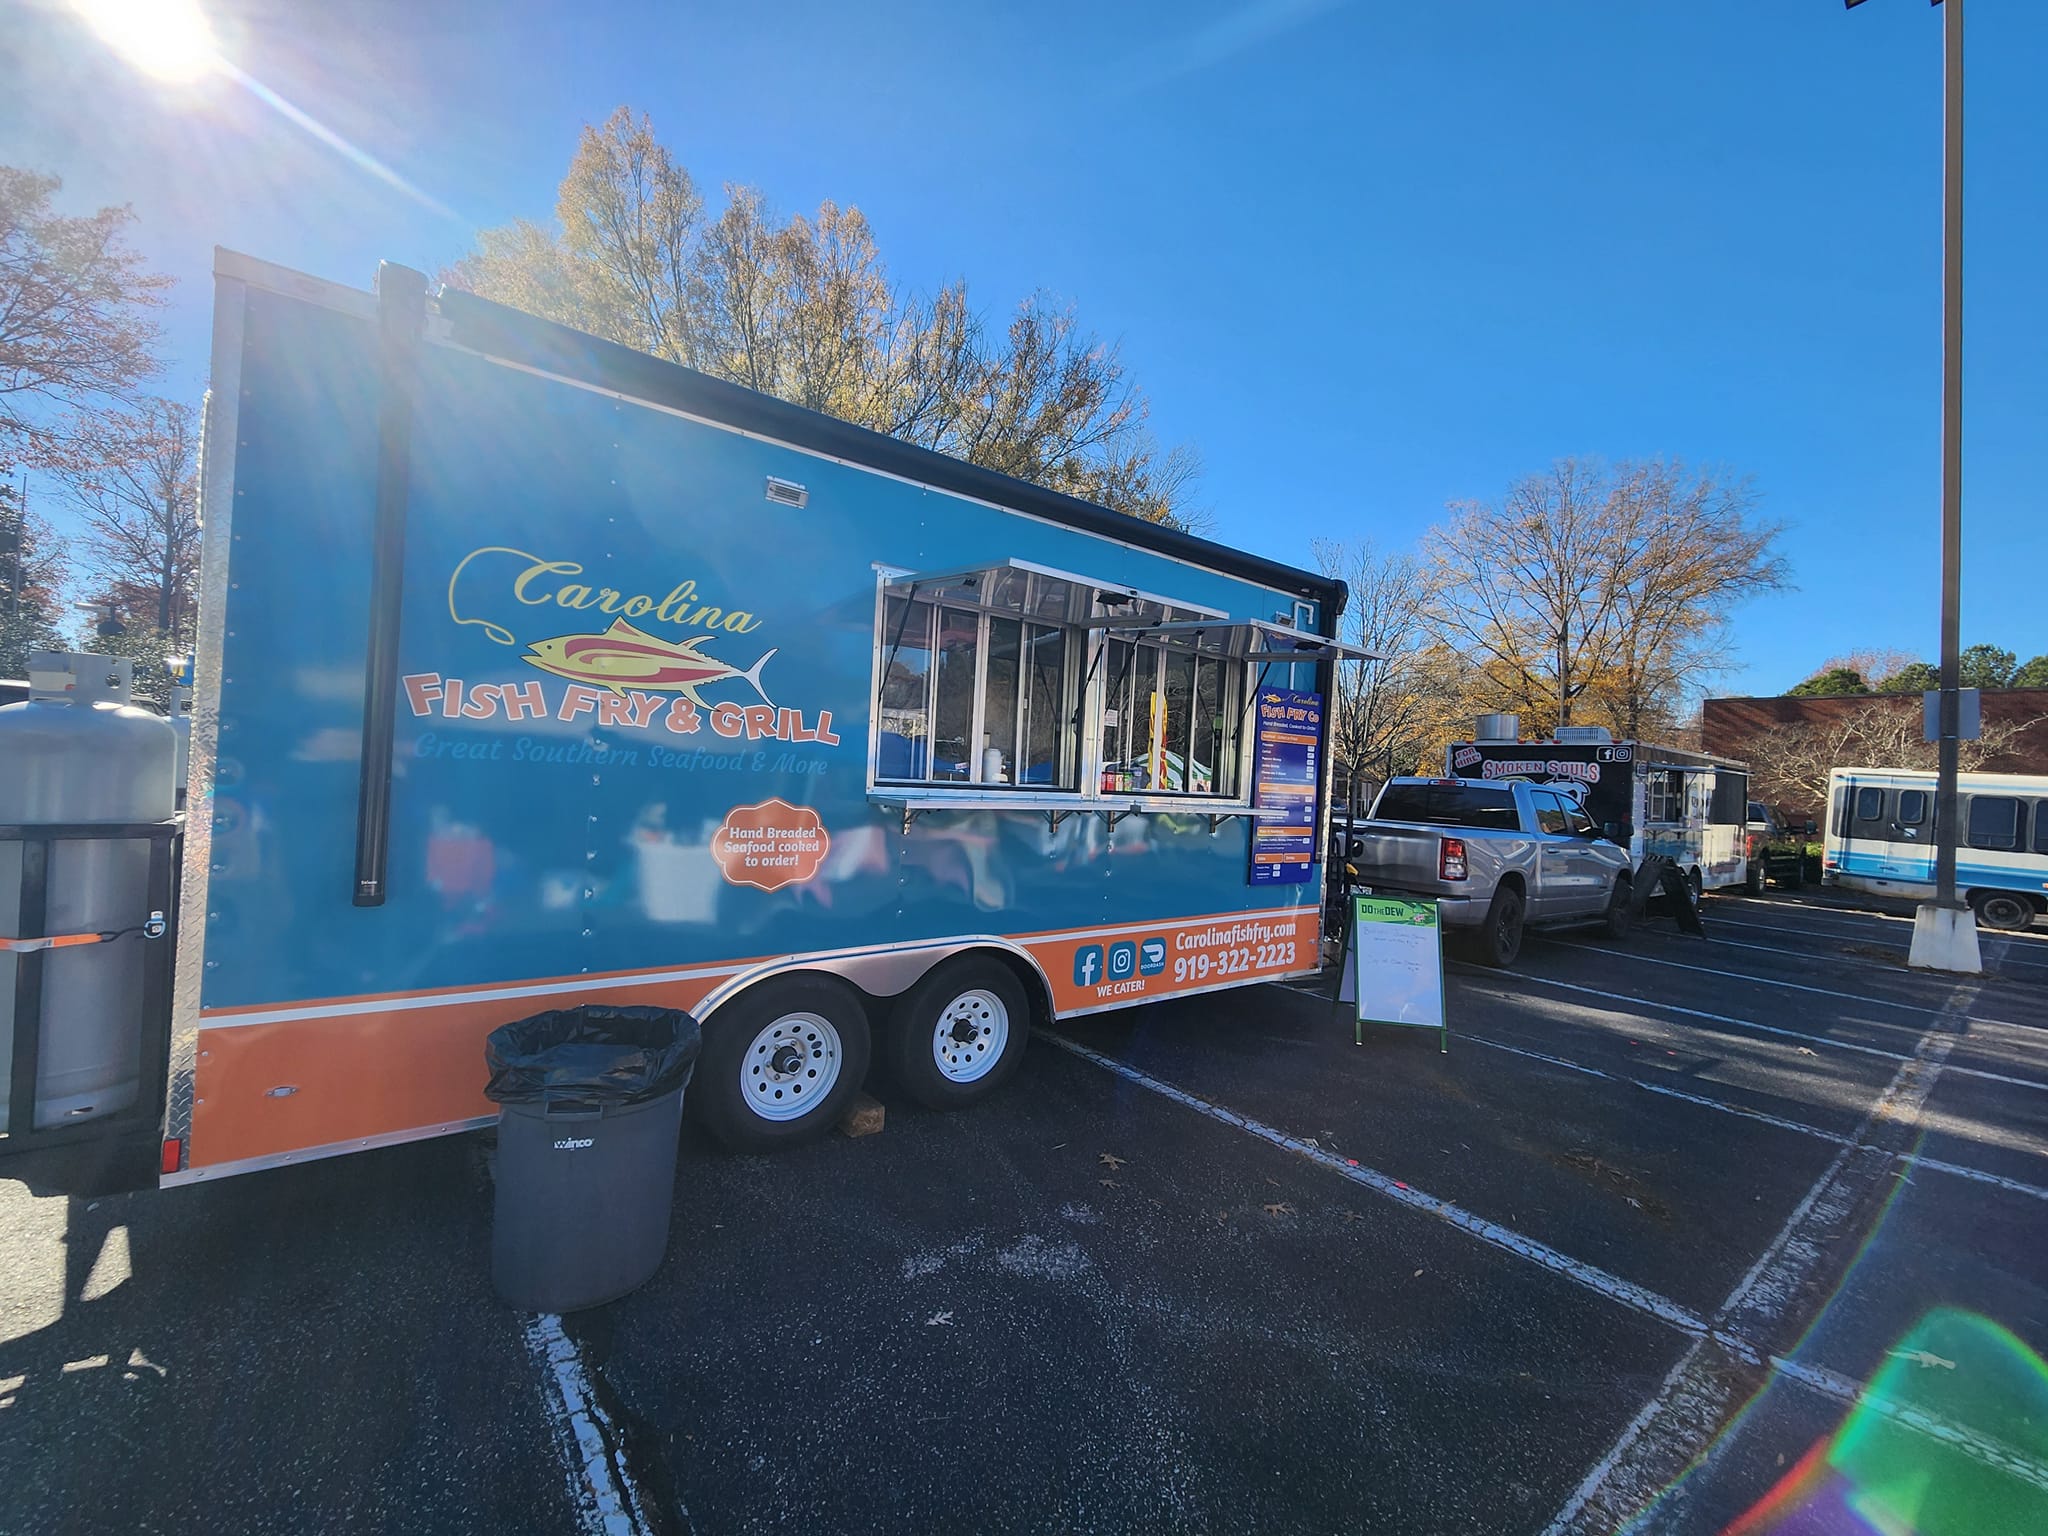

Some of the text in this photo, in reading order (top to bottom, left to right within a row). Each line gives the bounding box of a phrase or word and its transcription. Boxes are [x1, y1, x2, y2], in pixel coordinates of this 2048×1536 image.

[512, 560, 763, 634] Carolina
[402, 672, 841, 747] FISH FRY & GRILL
[1261, 703, 1286, 719] FISH
[1286, 706, 1308, 721] FRY
[413, 732, 829, 776] Great Southern Seafood & More
[1455, 747, 1475, 759] FOR
[1482, 759, 1599, 783] SMOKEN SOULS
[729, 827, 816, 839] Hand Breaded
[724, 840, 820, 855] Seafood cooked
[744, 854, 799, 867] to order!
[1361, 904, 1404, 917] DO THE DEW
[1175, 922, 1297, 951] Carolinafishfry.com
[1173, 942, 1296, 983] 919-322-2223
[1097, 980, 1145, 998] WE CATER!
